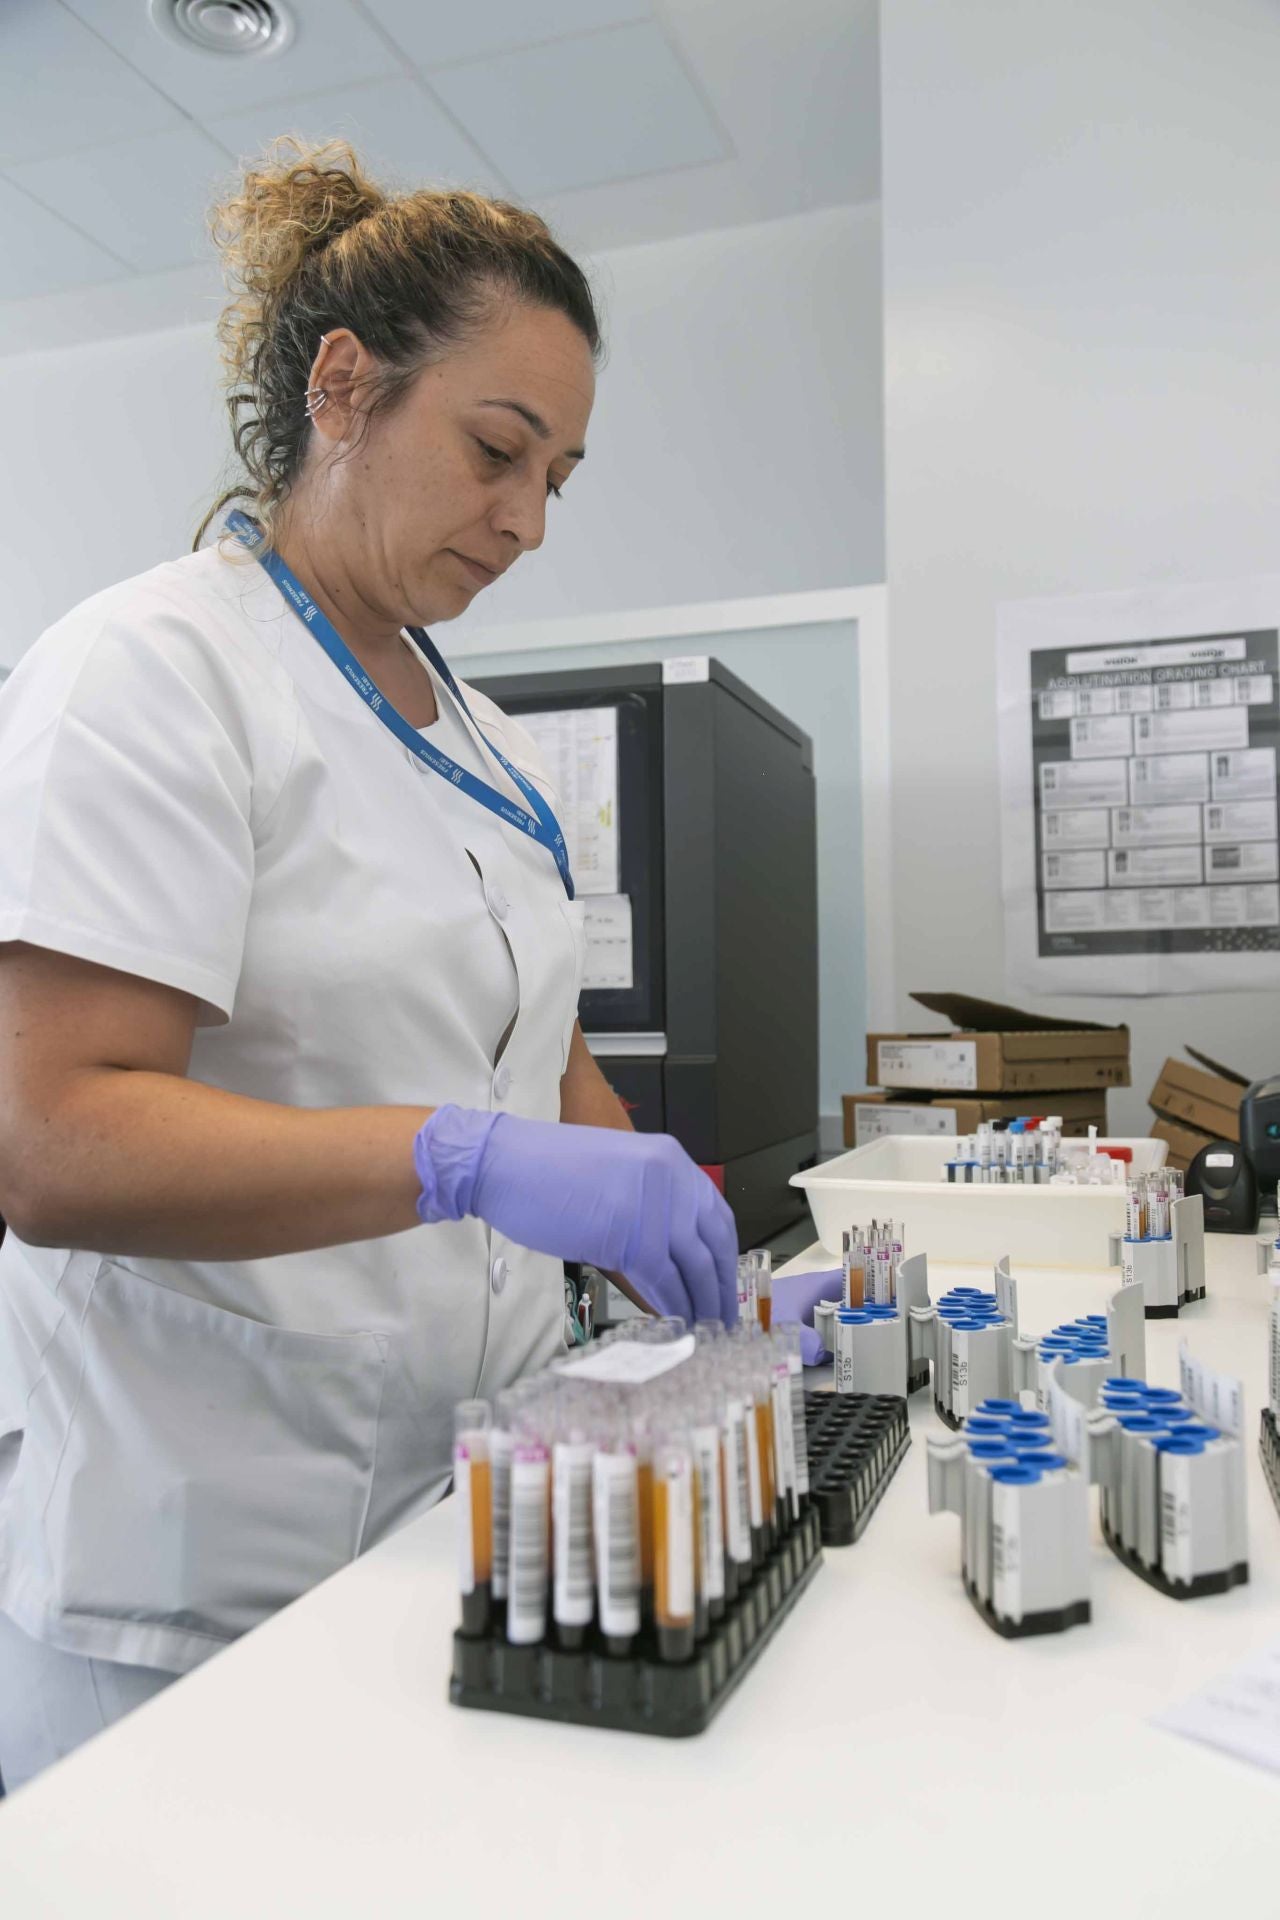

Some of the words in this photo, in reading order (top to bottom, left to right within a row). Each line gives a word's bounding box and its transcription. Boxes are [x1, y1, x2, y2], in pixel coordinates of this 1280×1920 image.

[282, 579, 305, 607] FRESENIUS
[345, 664, 369, 695] FRESENIUS
[1156, 664, 1216, 682] GRADING
[1221, 659, 1266, 675] CHART
[361, 675, 373, 691] KABI
[420, 749, 448, 773] FRESENIUS
[439, 757, 453, 769] KABI
[500, 806, 525, 826] FRESENIUS
[844, 1356, 852, 1382] S13b
[959, 1360, 968, 1387] S13b
